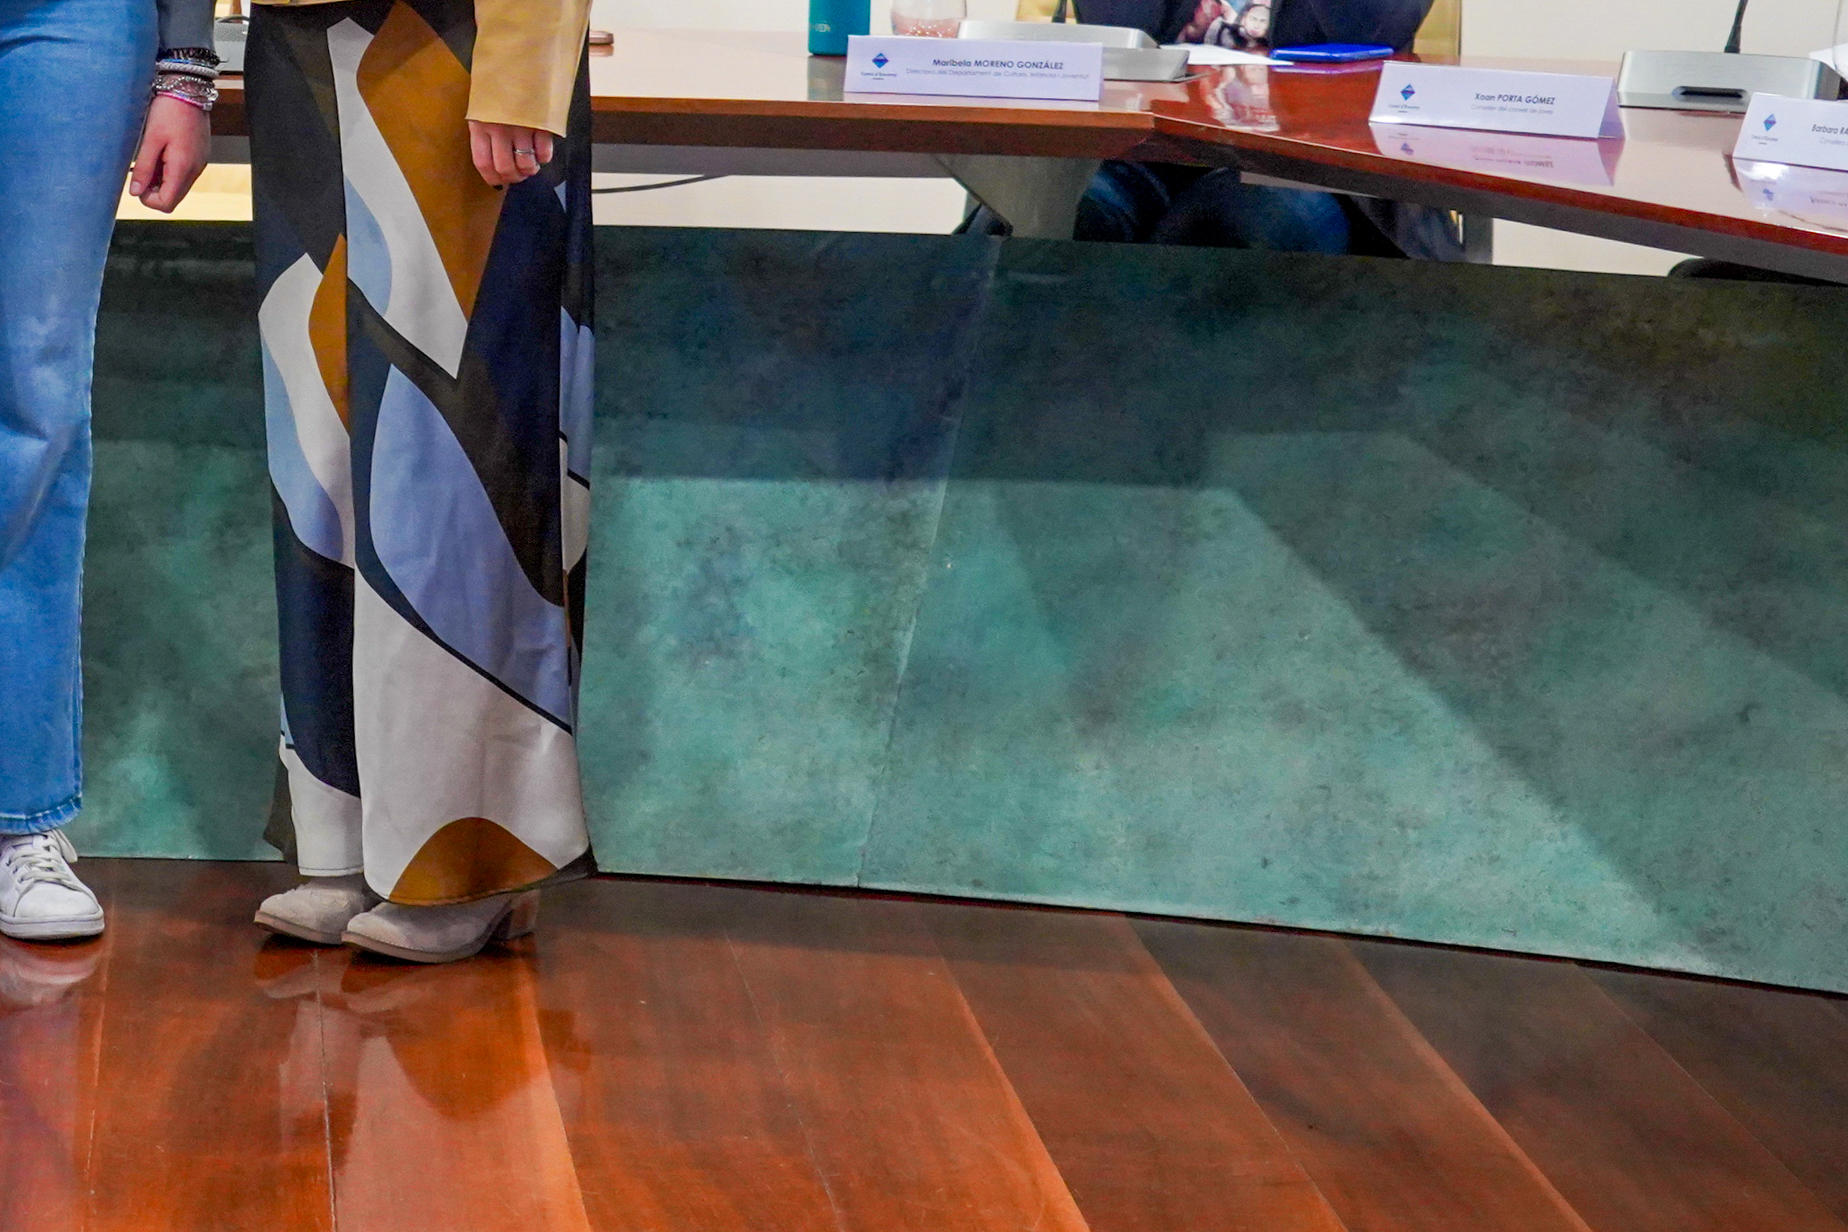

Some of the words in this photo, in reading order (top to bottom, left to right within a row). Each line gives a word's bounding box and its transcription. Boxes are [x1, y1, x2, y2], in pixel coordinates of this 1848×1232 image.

[933, 59, 971, 67] Maribela
[974, 60, 1014, 68] MORENO
[1017, 60, 1063, 70] GONZÁLEZ
[1474, 93, 1495, 101] Xoan
[1497, 94, 1522, 102] PORTA
[1525, 94, 1555, 105] GÓMEZ
[1811, 123, 1839, 134] Barbara
